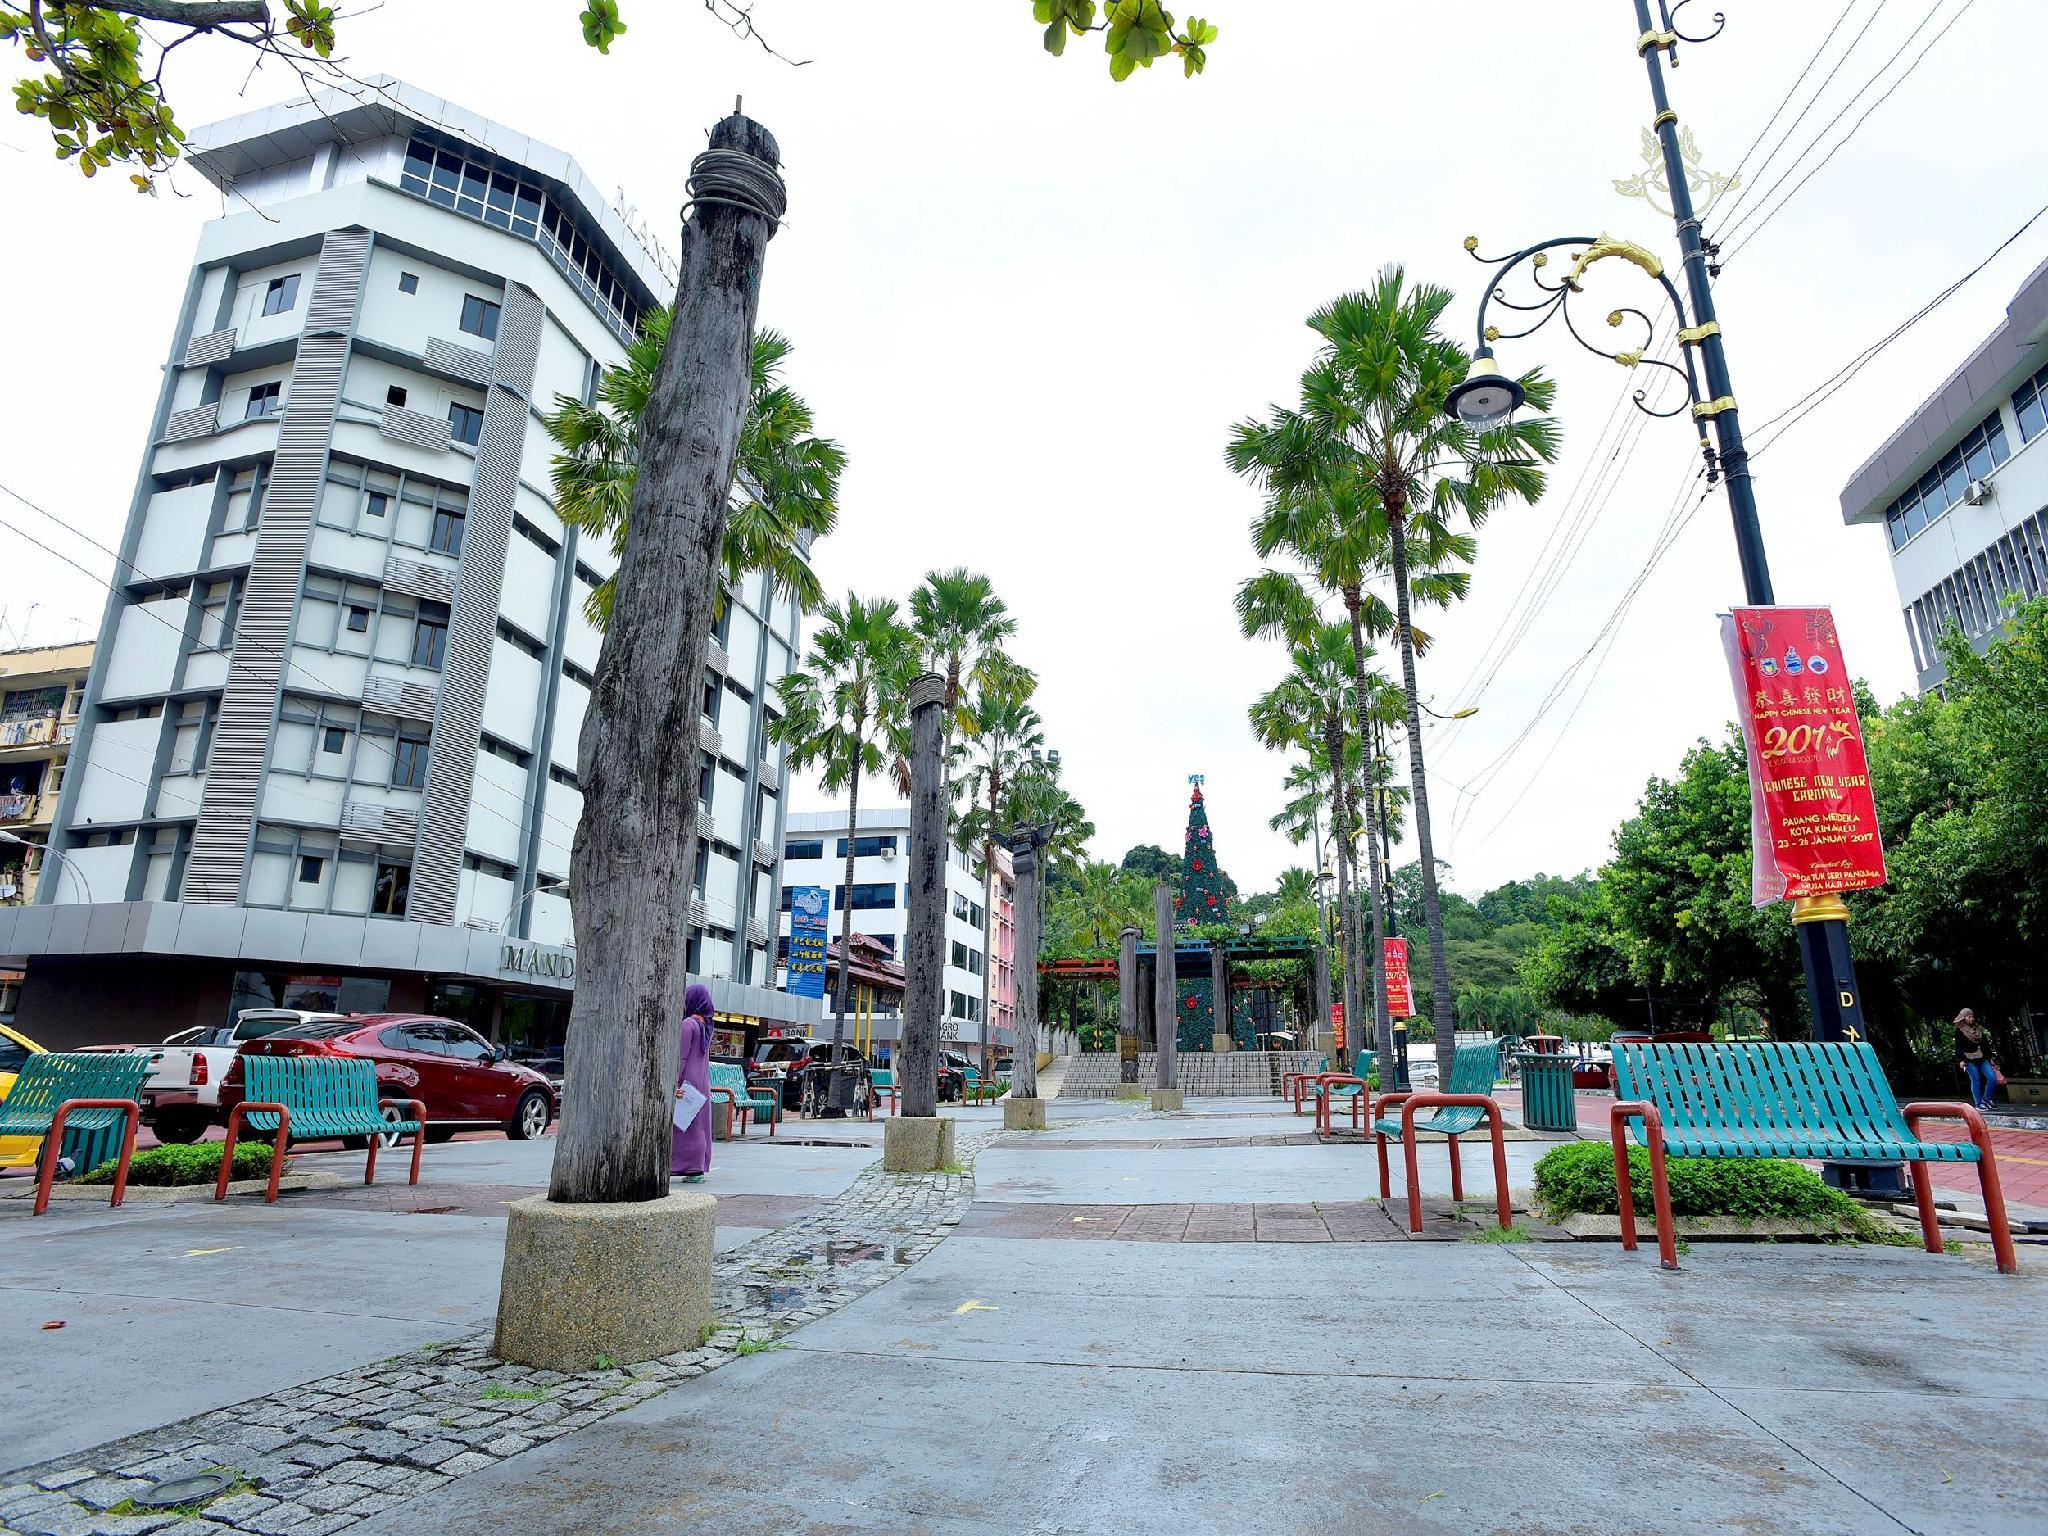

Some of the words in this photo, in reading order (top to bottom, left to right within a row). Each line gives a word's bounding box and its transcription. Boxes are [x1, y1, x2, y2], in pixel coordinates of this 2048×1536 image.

[1755, 686, 1846, 709] 恭喜發財
[1754, 710, 1779, 720] HAPPY
[1781, 707, 1812, 717] CHINESE
[1813, 707, 1828, 715] NEW
[1831, 706, 1851, 715] YEAR
[1188, 774, 1205, 784] yes
[1764, 776, 1807, 793] CHINESE
[1813, 774, 1834, 787] NEW
[1838, 774, 1866, 787] YEAR
[1782, 814, 1820, 827] PADANG
[1822, 812, 1861, 823] MEDEKA
[1789, 827, 1813, 837] KOTA
[1777, 839, 1789, 849] 23
[1798, 838, 1809, 847] 26
[1811, 834, 1847, 845] JANUAY
[1850, 832, 1874, 843] 2017
[1800, 873, 1826, 882] DATUK
[1826, 871, 1843, 880] SERI
[1824, 880, 1843, 889] HAJI
[1844, 879, 1867, 887] AMAN
[504, 944, 575, 979] MAND
[785, 1029, 807, 1038] BANK
[940, 1031, 959, 1041] ANK
